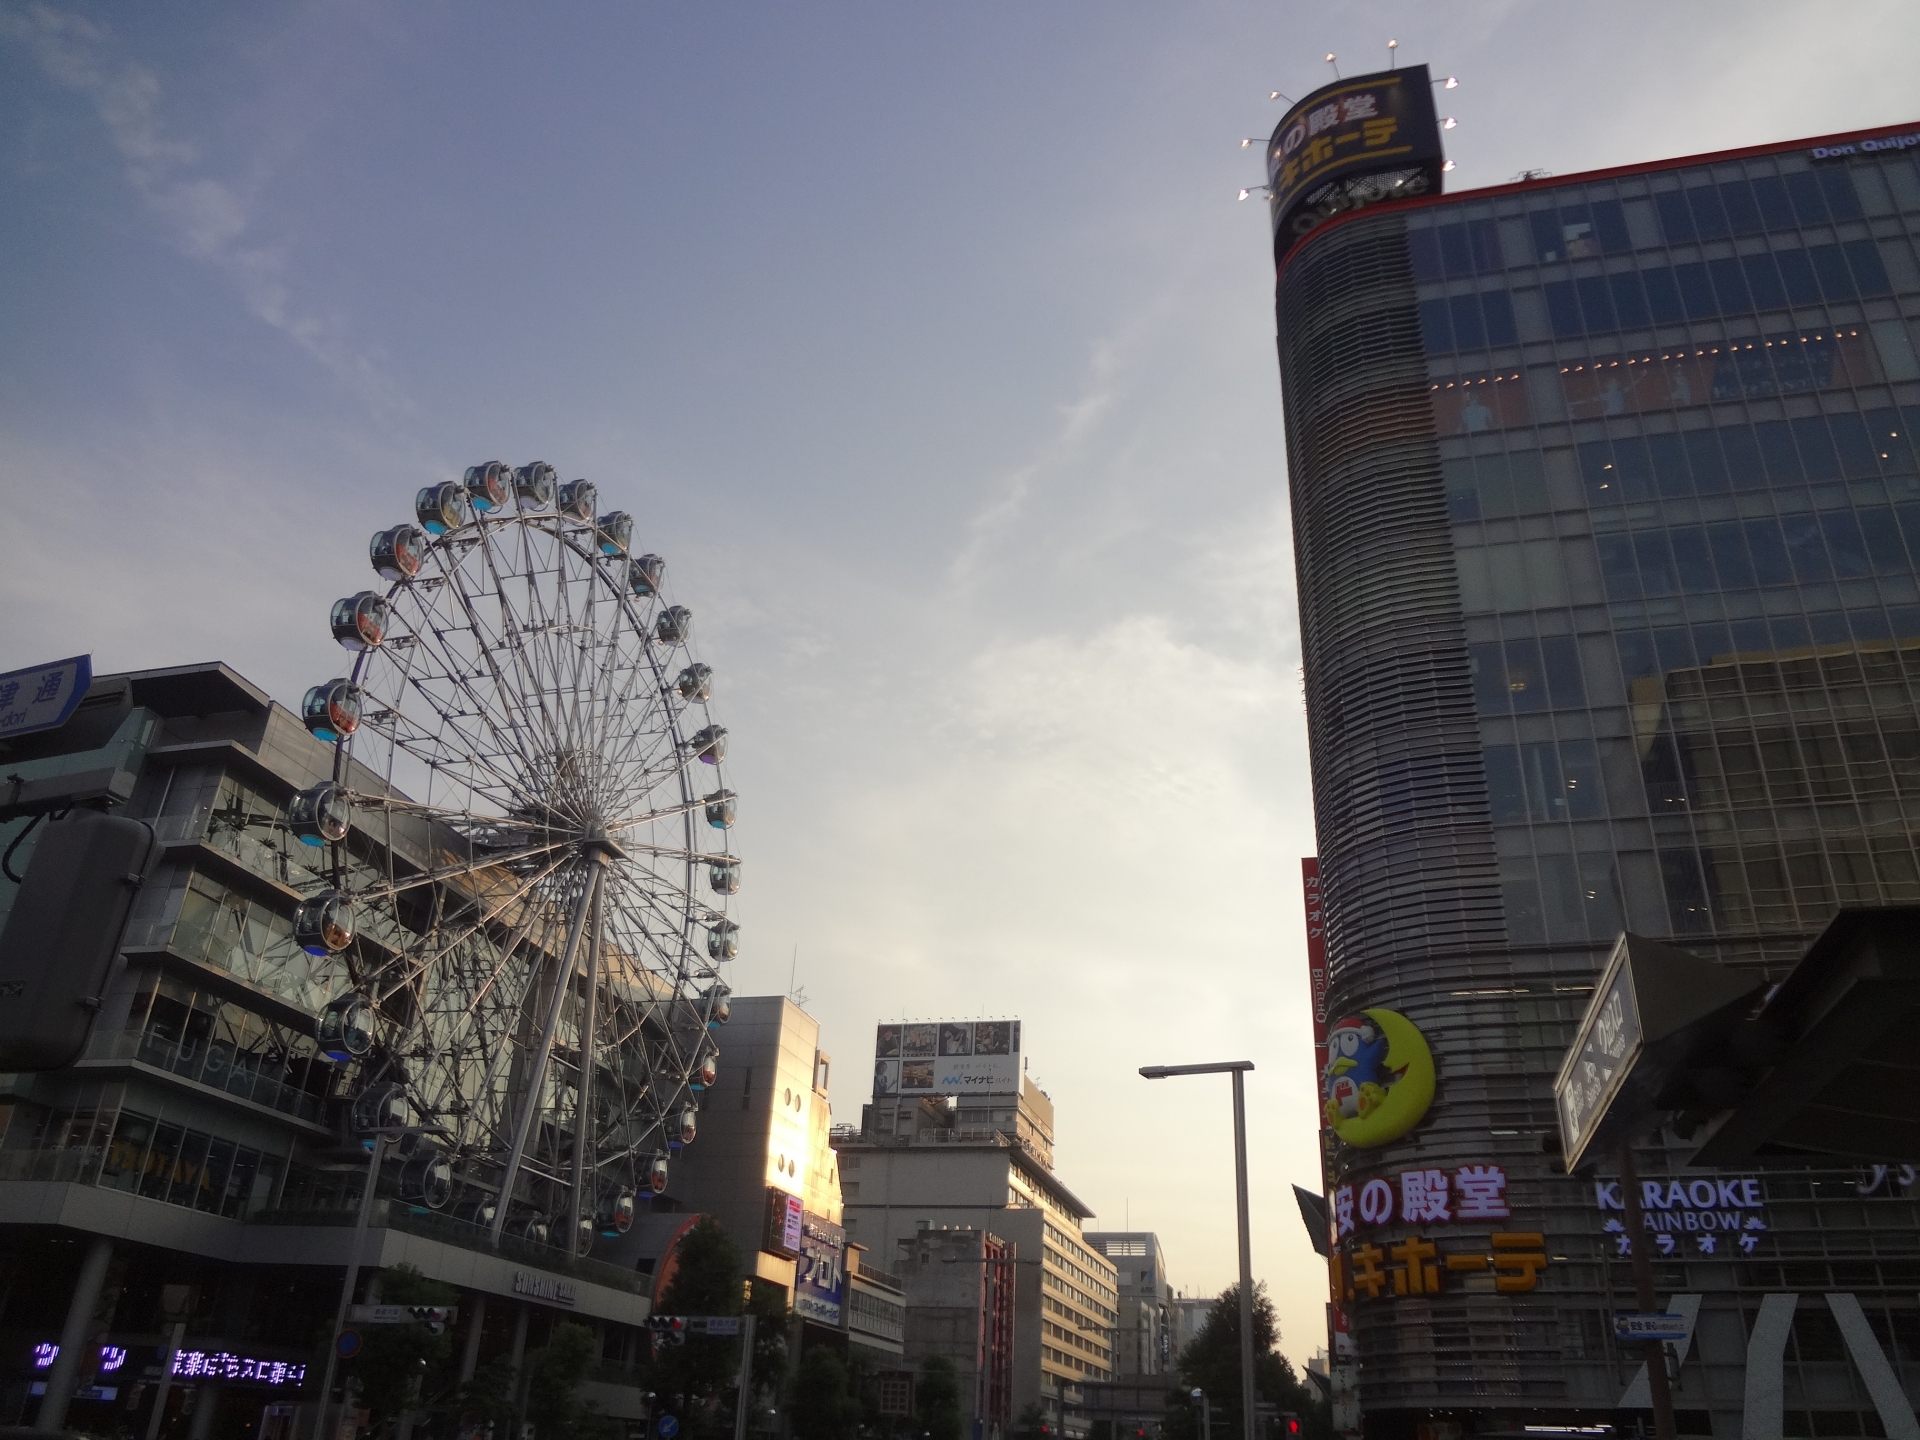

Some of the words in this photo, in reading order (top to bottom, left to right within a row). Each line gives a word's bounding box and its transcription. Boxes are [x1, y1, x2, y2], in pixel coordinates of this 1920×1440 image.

[1812, 145, 1856, 159] Don
[1306, 876, 1323, 939] カラオケ
[963, 1075, 994, 1085] マイナビ
[1595, 1178, 1764, 1210] KRAOKE
[1643, 1210, 1743, 1232] AINBOW
[1616, 1233, 1759, 1254] カラオケ
[515, 1271, 560, 1300] SUNSHINE
